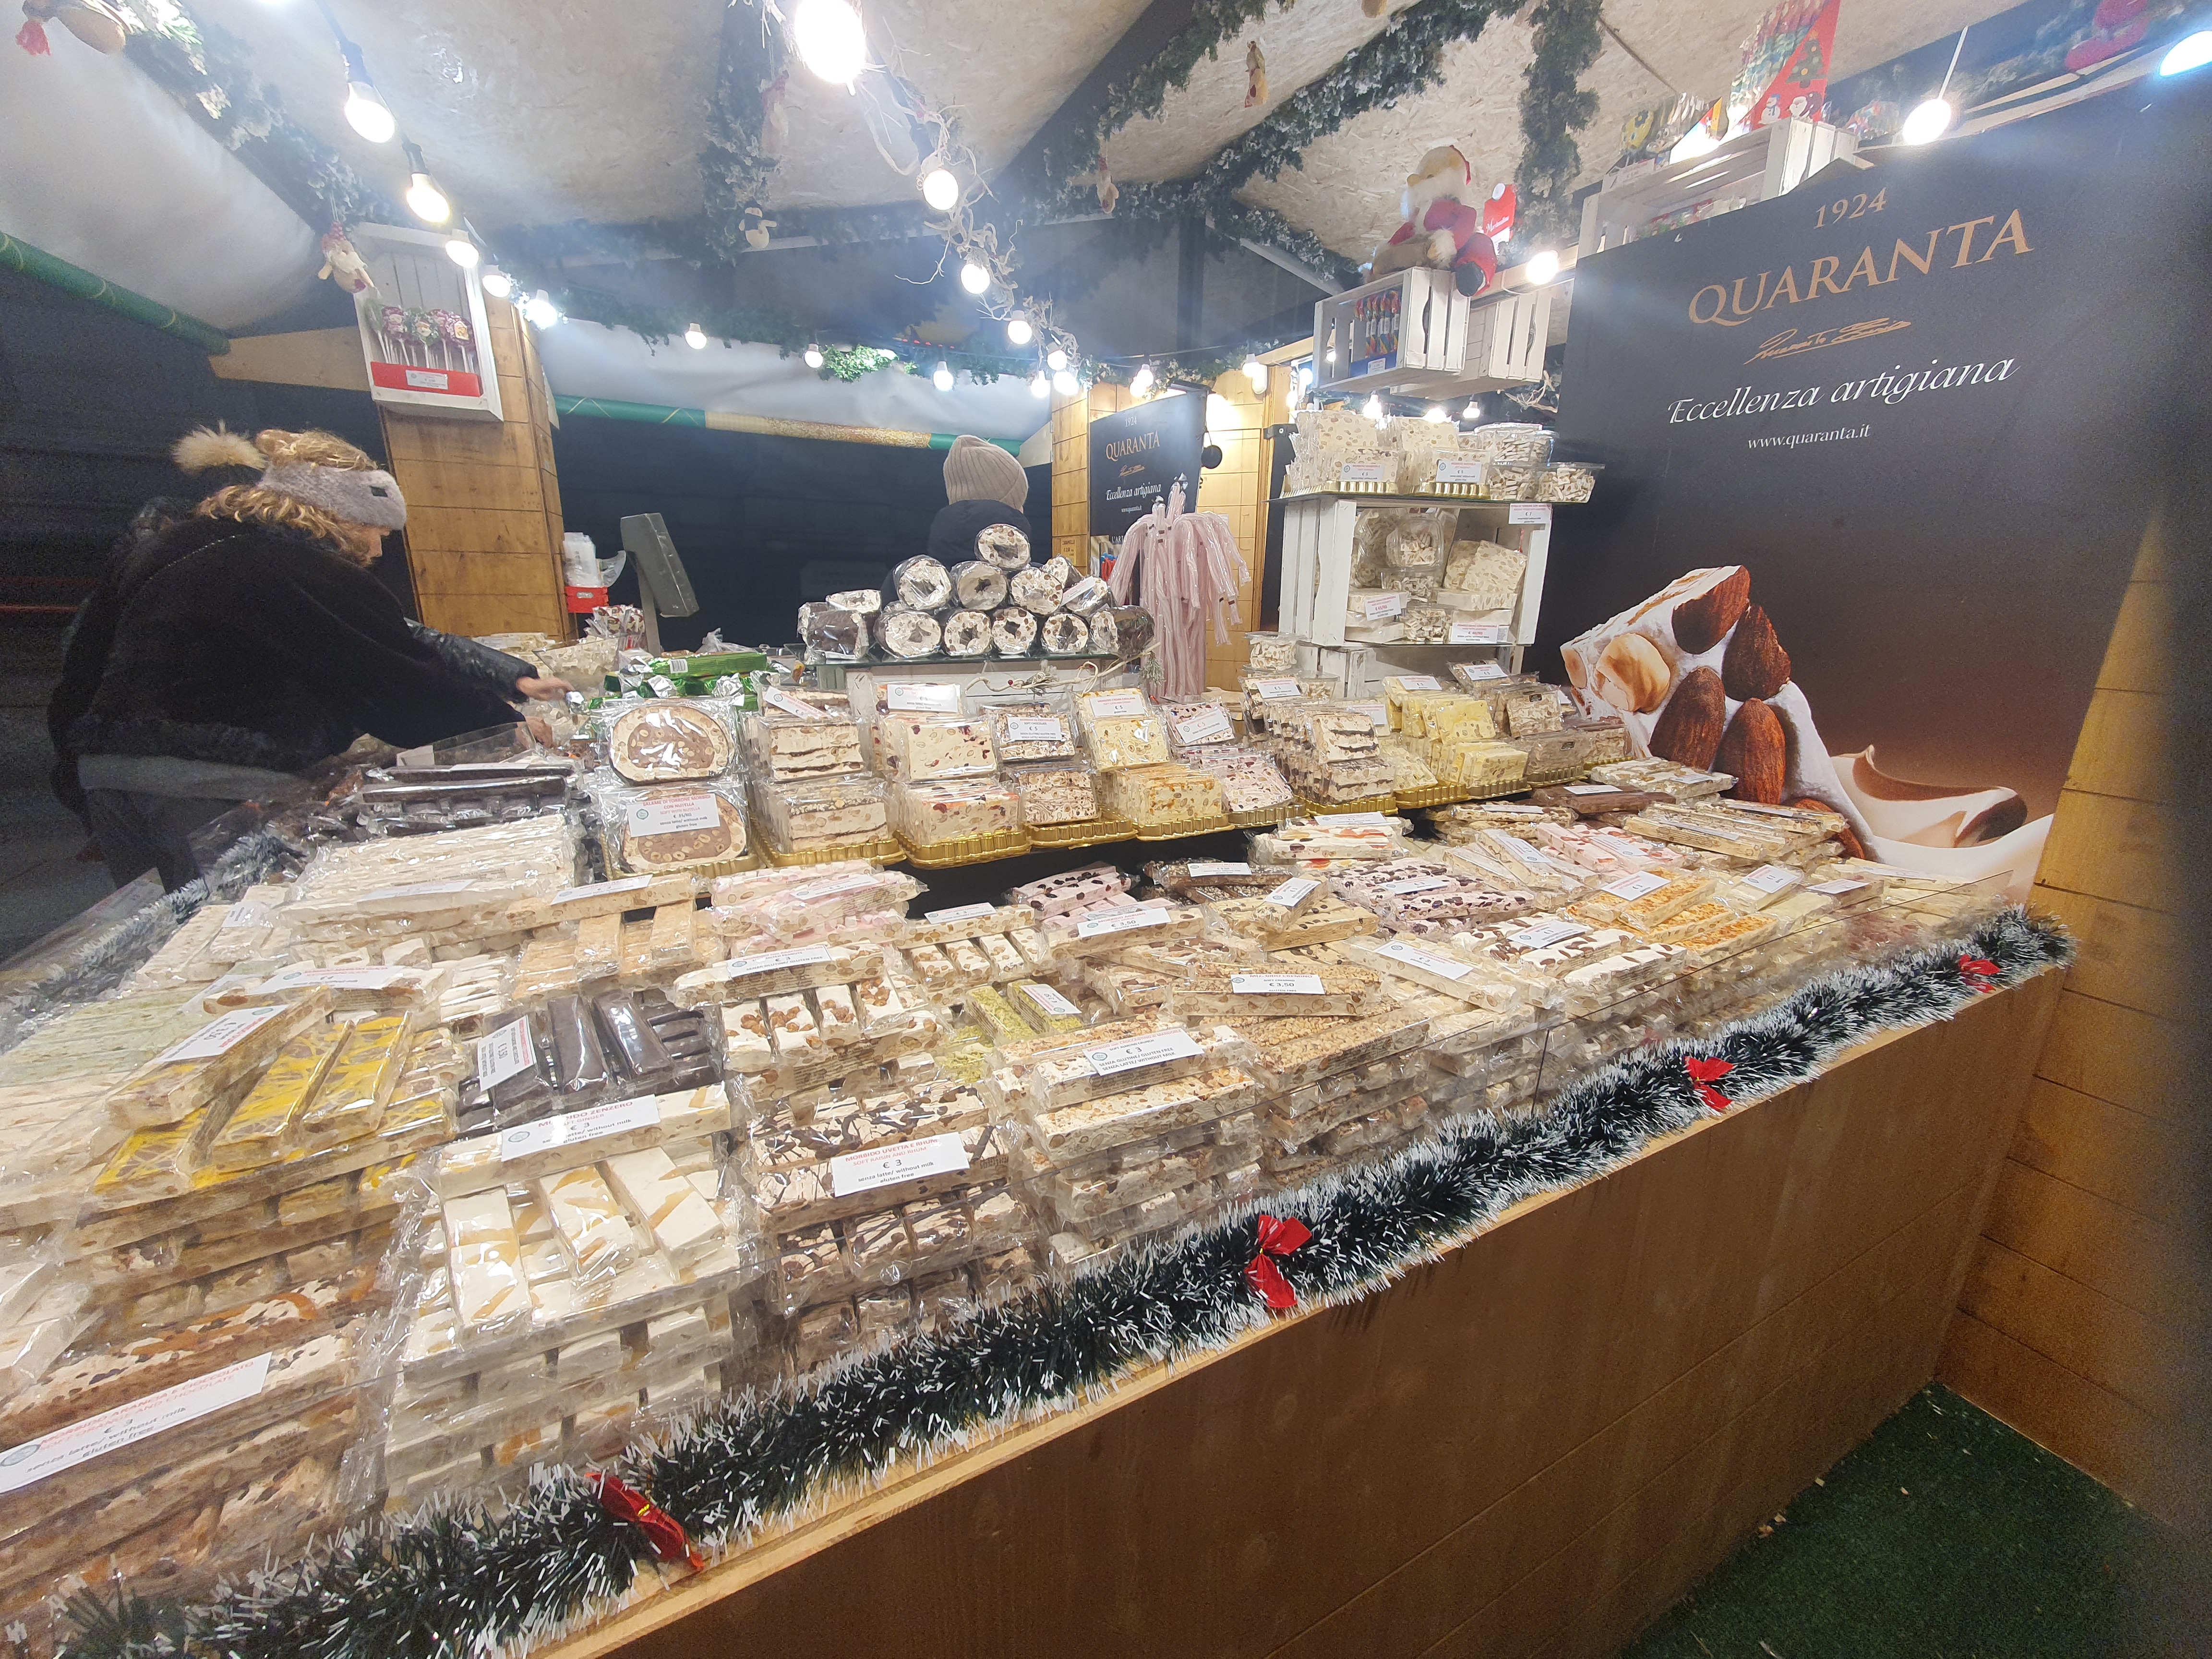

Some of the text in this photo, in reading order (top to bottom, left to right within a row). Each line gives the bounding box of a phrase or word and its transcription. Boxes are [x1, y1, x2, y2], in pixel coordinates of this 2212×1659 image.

[1814, 187, 1887, 229] 1924
[1689, 208, 2035, 327] QUARANTA
[1668, 358, 2021, 424] Eccellenza artigiana
[1125, 415, 1137, 428] 1924
[1747, 424, 1872, 449] www.quaranta.it
[1106, 430, 1160, 462] QUARANTA
[1106, 481, 1161, 500] Eccellenza artigiana
[1115, 1054, 1142, 1063] GLUTINE/
[1139, 1049, 1162, 1058] GLUTEN
[1137, 1054, 1163, 1063] WITHOUT
[589, 1101, 633, 1115] ZENZERO
[587, 1122, 615, 1132] without
[563, 1134, 587, 1144] gluten
[845, 1150, 881, 1162] MORBIDO
[882, 1144, 909, 1154] UVETTA
[853, 1158, 869, 1166] SOFT
[869, 1154, 891, 1163] RAISIN
[907, 1146, 927, 1154] RHUM
[894, 1158, 902, 1166] 3
[857, 1174, 876, 1182] senza
[877, 1169, 894, 1178] latte/
[895, 1164, 920, 1174] without
[103, 1425, 114, 1434] €
[108, 1416, 158, 1441] without
